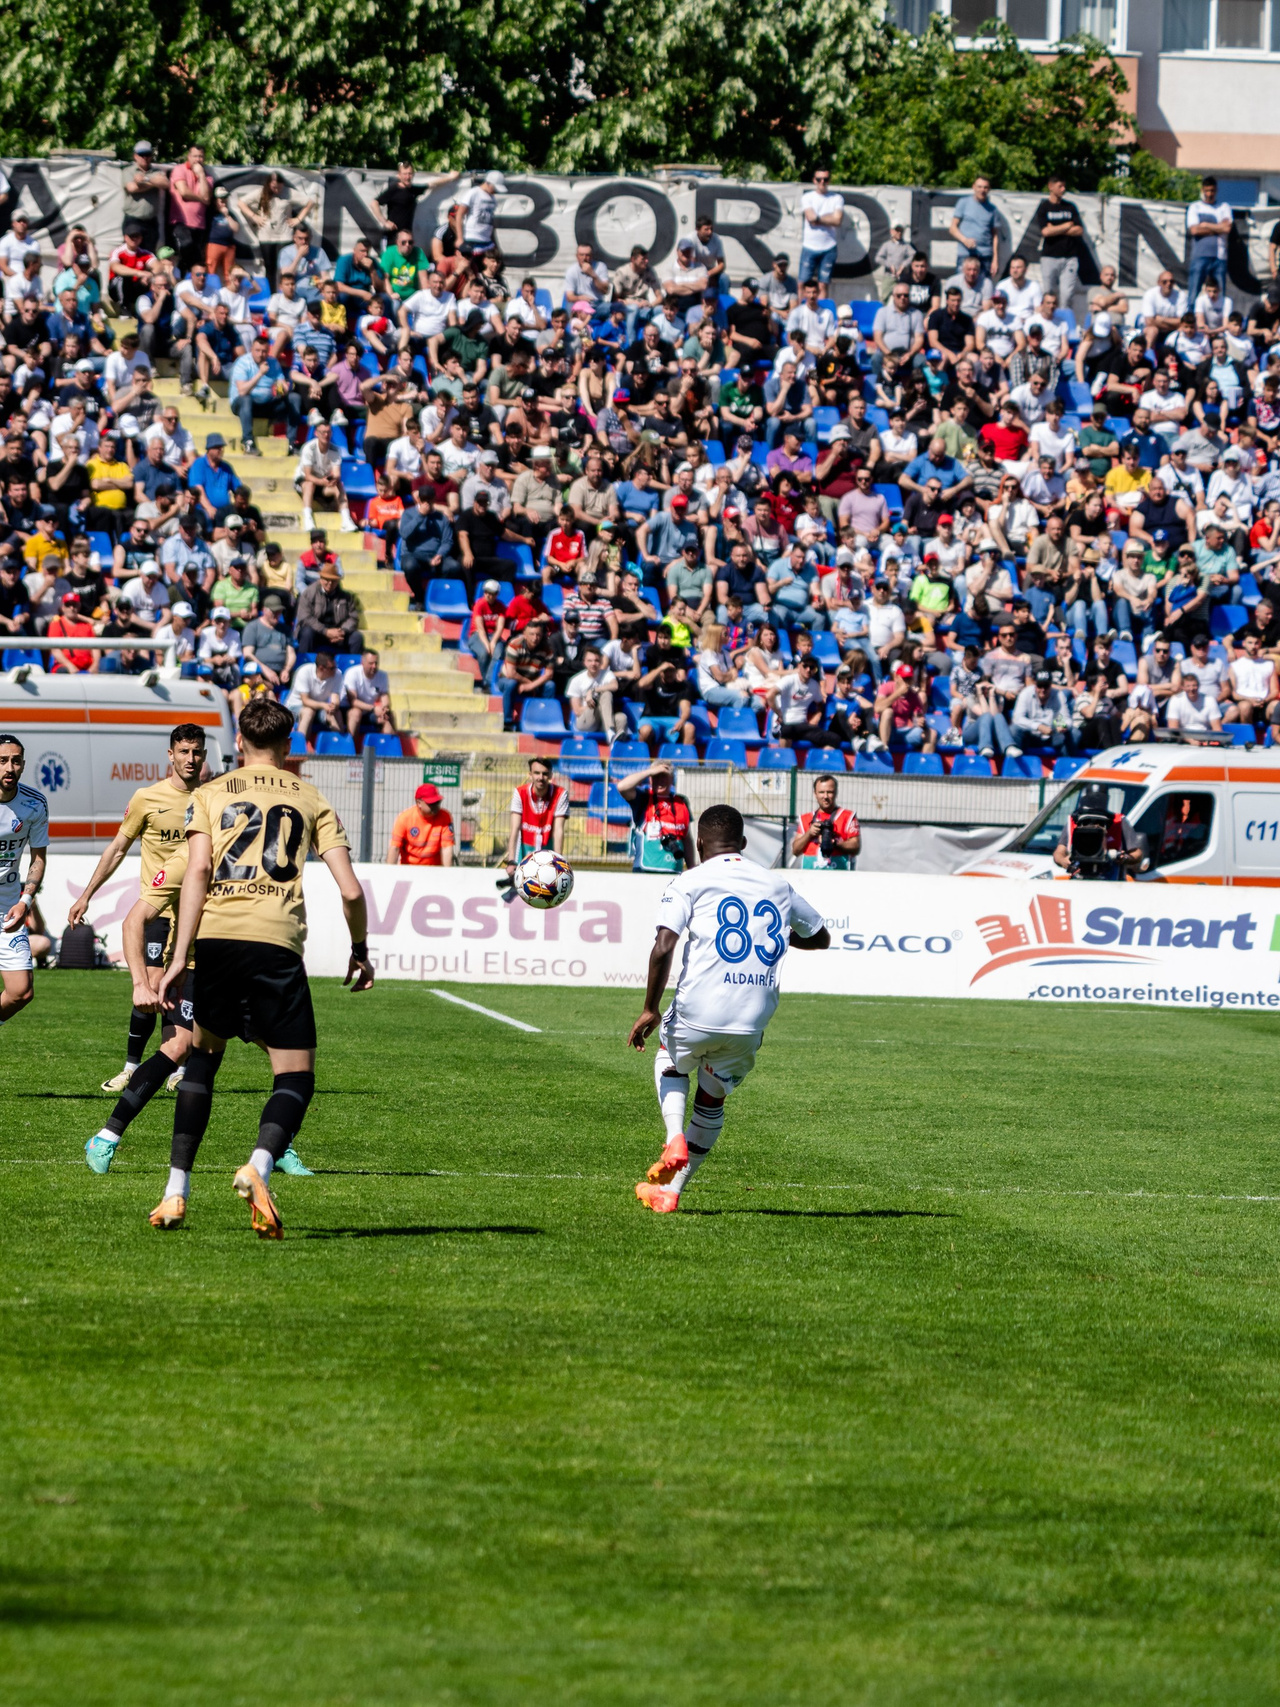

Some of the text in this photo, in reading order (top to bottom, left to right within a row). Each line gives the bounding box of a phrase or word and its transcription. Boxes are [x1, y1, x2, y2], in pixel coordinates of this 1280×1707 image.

[384, 633, 395, 648] 5
[110, 763, 174, 781] AMBULA
[425, 765, 458, 776] IESIRE
[254, 775, 300, 792] HILS
[214, 800, 305, 883] 20
[238, 883, 296, 903] HOSPITAL
[359, 878, 623, 944] Vestra
[715, 896, 785, 967] 83
[825, 915, 850, 930] pul
[1081, 906, 1258, 951] Smart
[828, 933, 952, 954] SACO
[483, 951, 588, 977] Elsaco
[1037, 983, 1280, 1008] contoareinteligente
